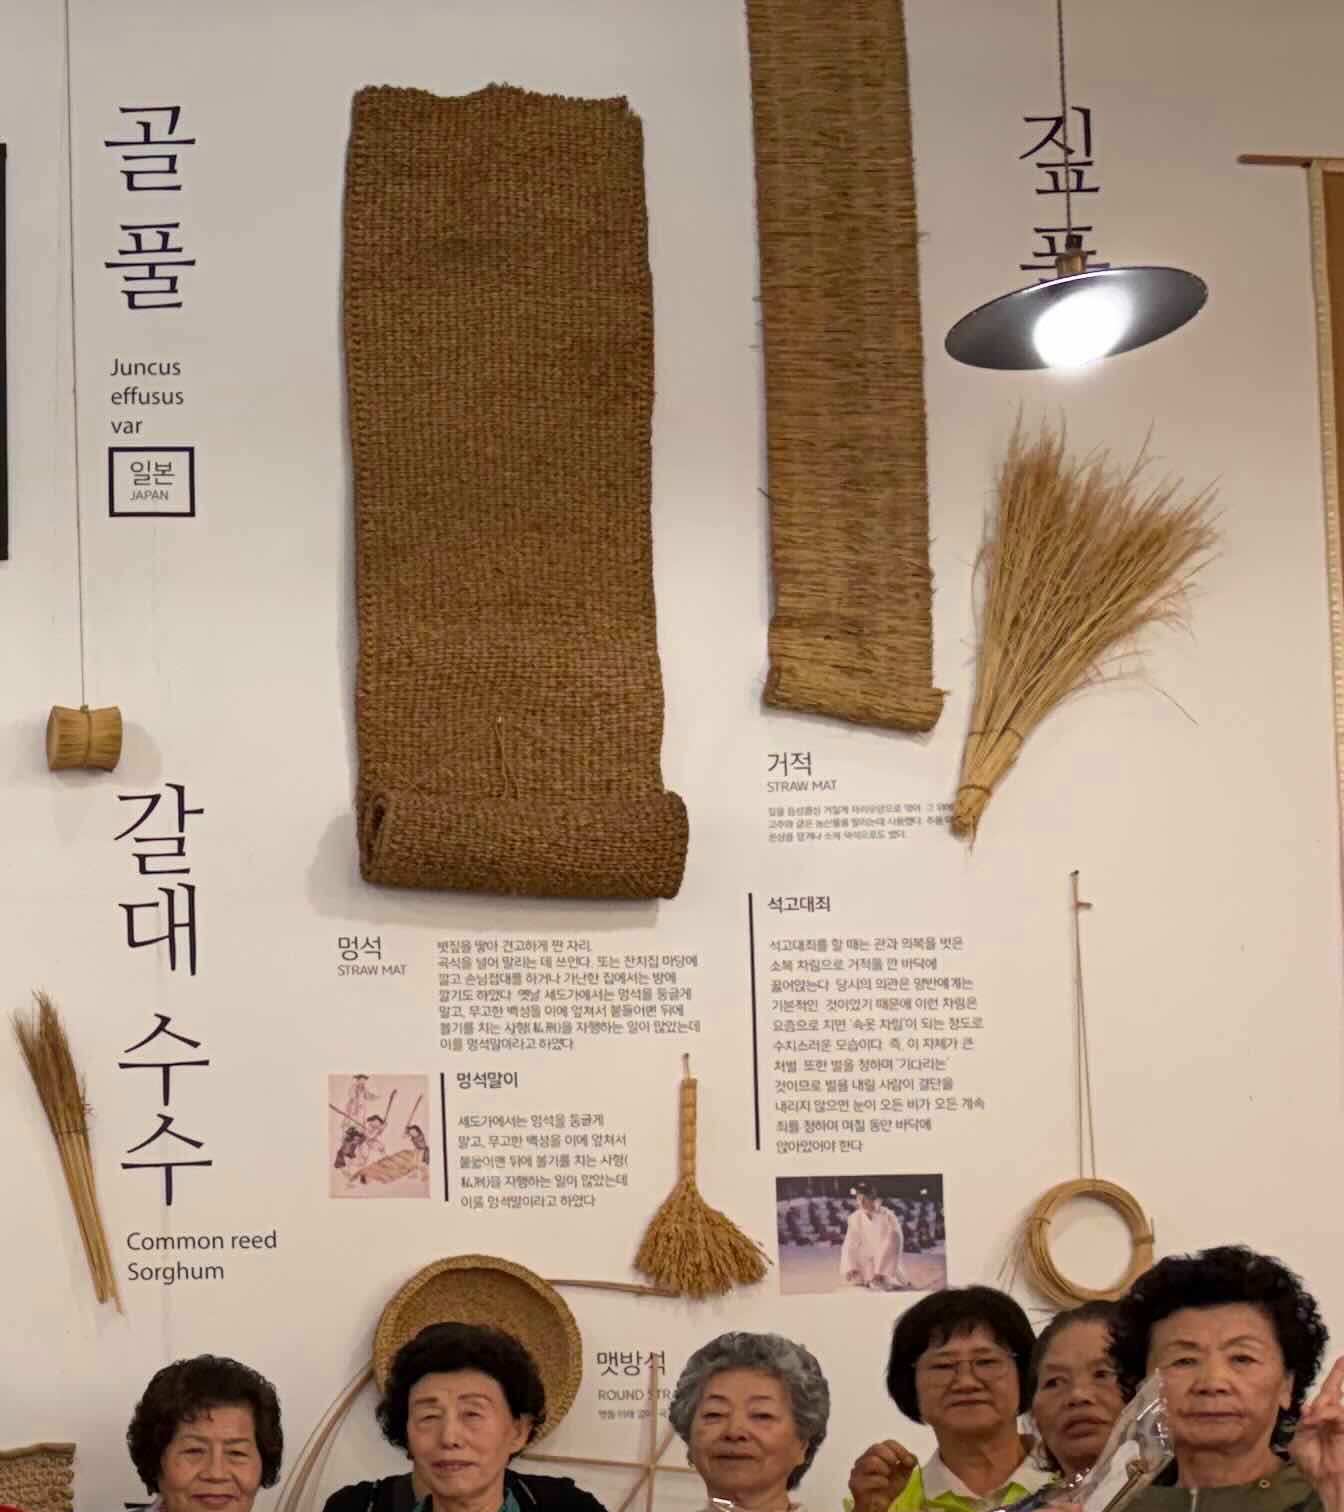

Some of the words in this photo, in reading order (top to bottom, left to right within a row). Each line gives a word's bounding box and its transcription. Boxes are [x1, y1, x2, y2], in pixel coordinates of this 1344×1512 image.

[104, 106, 196, 310] 골풀
[111, 359, 180, 376] Juncus
[111, 386, 184, 405] effusus
[111, 421, 142, 434] var
[130, 461, 175, 486] 일본
[130, 489, 168, 500] JAPAN
[768, 752, 811, 776] 거적
[767, 781, 808, 792] STRAW
[812, 780, 836, 791] MAT
[114, 783, 204, 976] 갈대
[768, 896, 830, 913] 석고대죄
[338, 936, 381, 961] 멍석
[337, 964, 377, 976] STRAW
[382, 964, 407, 975] MAT
[457, 1072, 518, 1089] 멍석말이
[118, 1014, 212, 1206] 수수
[127, 1232, 224, 1250] Common
[232, 1230, 276, 1249] reed
[128, 1261, 224, 1285] Sorghum
[598, 1389, 644, 1401] ROUND
